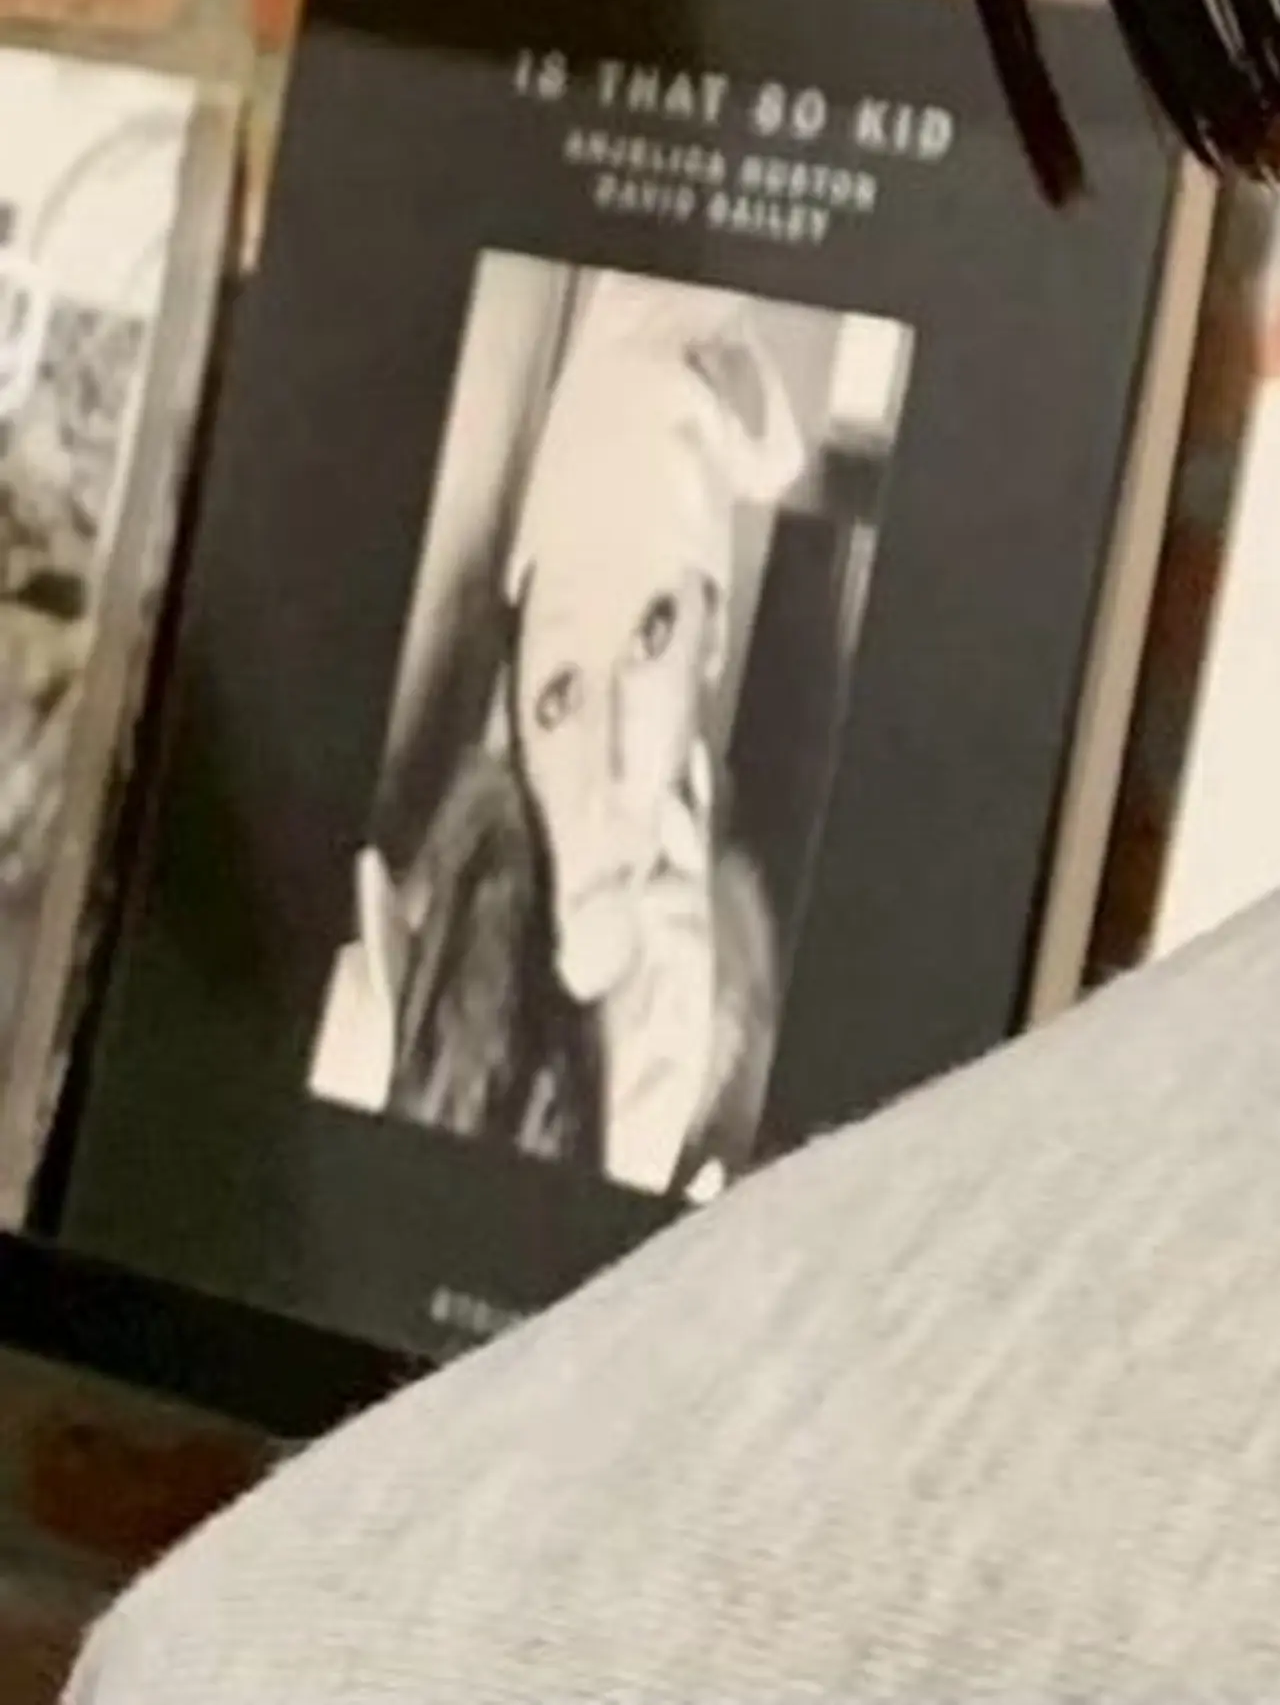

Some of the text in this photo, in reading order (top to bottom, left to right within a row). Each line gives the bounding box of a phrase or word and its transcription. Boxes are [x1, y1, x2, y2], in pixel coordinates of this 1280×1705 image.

[513, 47, 954, 163] IS THAT SO KID
